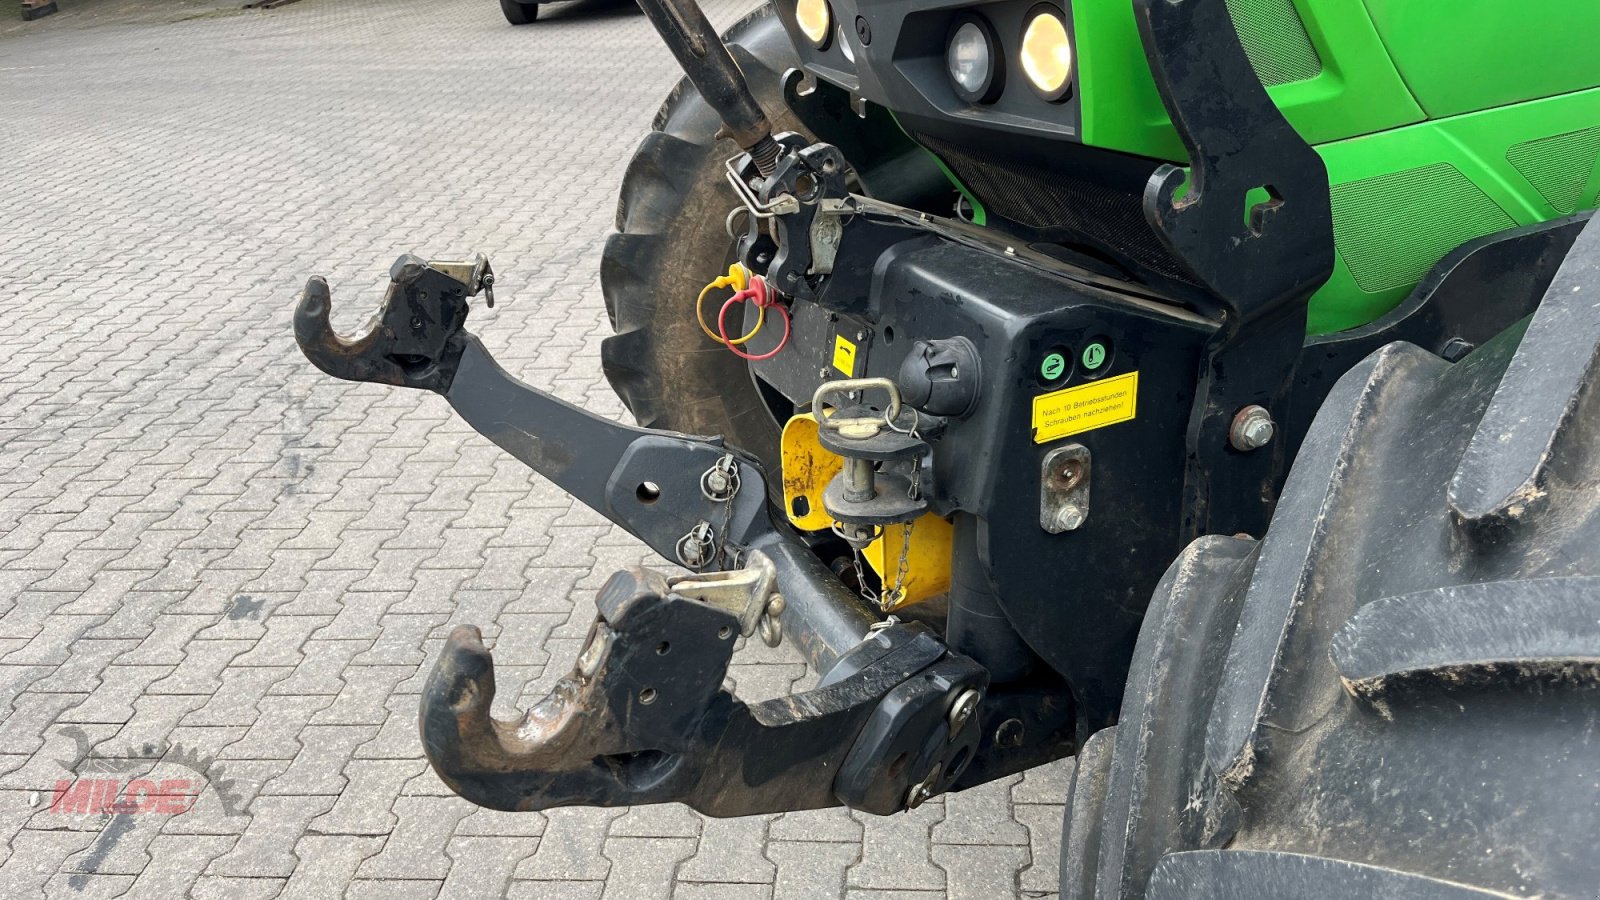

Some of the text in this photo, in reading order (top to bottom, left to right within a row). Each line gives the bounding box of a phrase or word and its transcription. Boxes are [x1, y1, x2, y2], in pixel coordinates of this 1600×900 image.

[1042, 390, 1127, 417] Nach 10 Betriebsstunden
[1044, 401, 1124, 428] Schrauben nachziehen!
